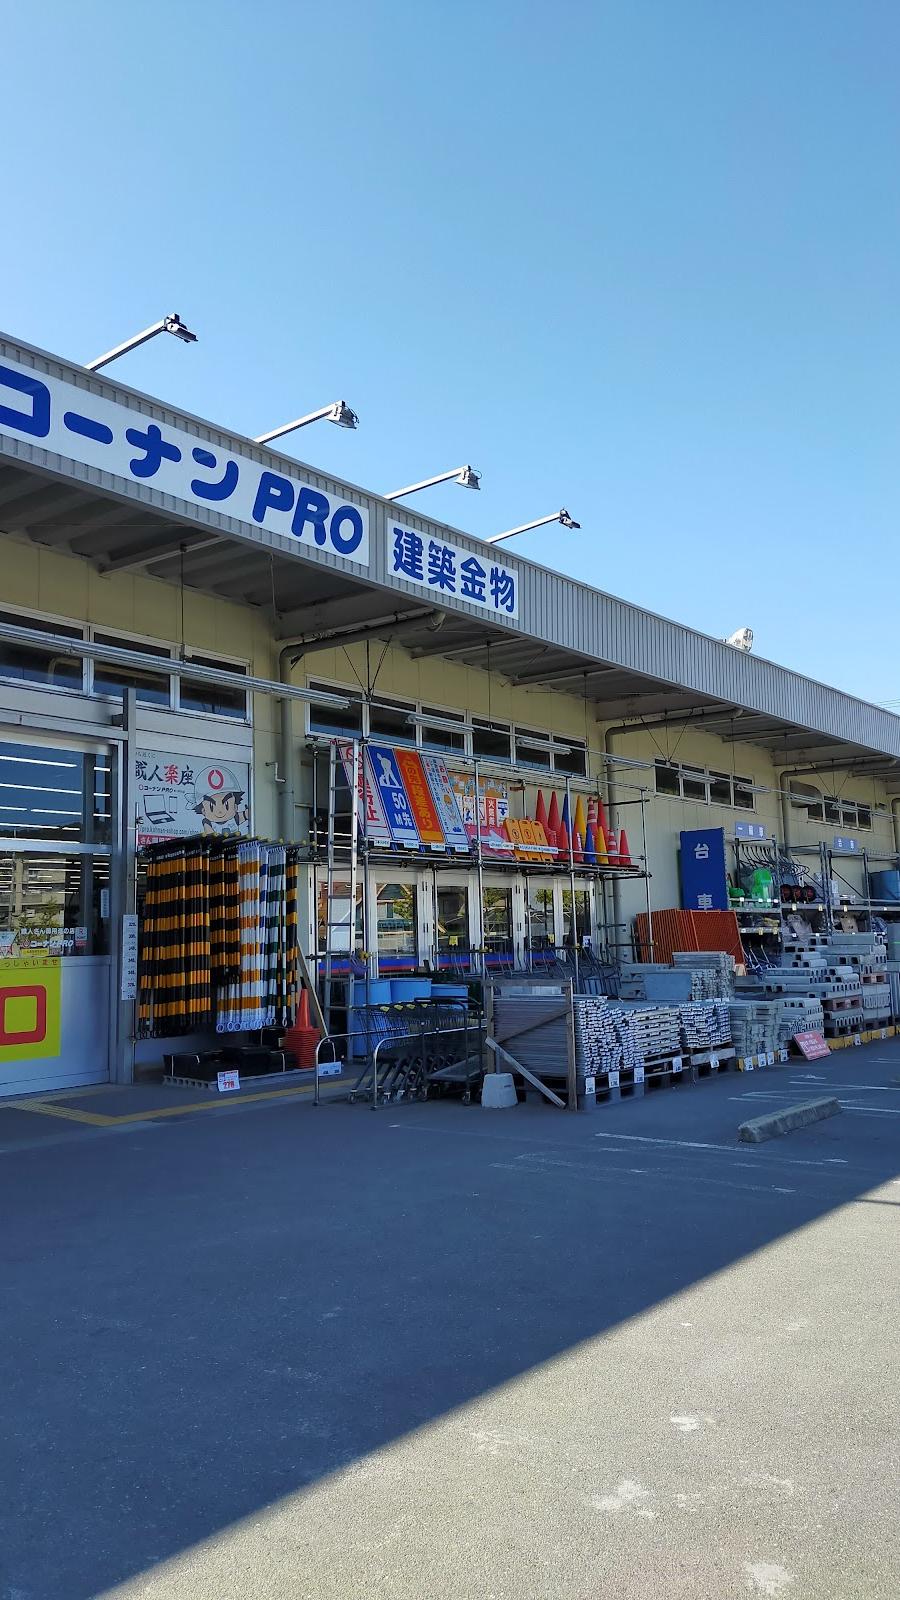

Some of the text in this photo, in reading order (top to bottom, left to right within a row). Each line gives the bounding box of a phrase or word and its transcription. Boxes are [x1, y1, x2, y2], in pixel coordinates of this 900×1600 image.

[252, 472, 363, 555] PRO
[393, 527, 516, 613] 建築金物
[391, 792, 407, 810] 50
[694, 843, 713, 910] 台車
